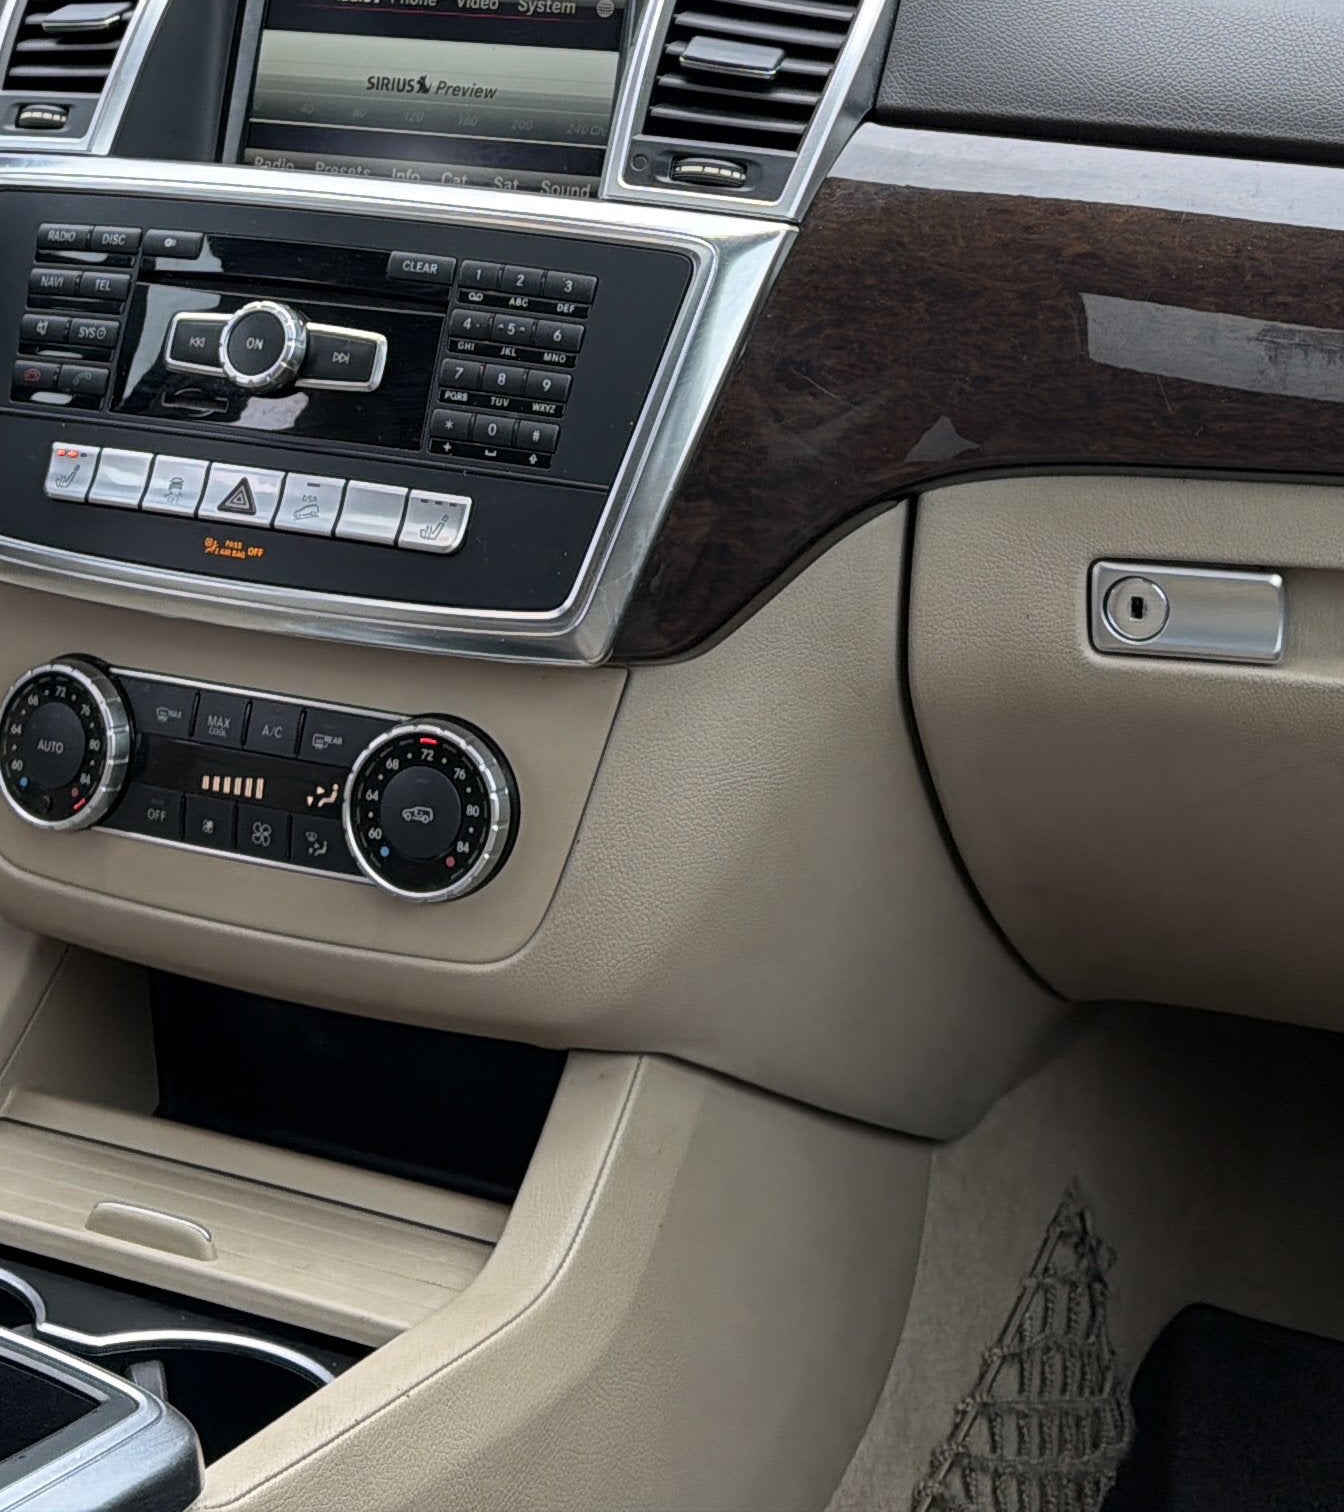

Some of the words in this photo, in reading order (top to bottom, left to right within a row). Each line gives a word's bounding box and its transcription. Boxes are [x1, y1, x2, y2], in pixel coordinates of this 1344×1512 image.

[366, 75, 416, 94] SIRIUS
[434, 81, 499, 100] Preview
[541, 180, 591, 199] Sound
[47, 230, 77, 242] RADIO
[101, 234, 126, 246] DISC
[402, 260, 438, 274] CLEAR
[40, 275, 64, 287] NAVI
[476, 269, 482, 281] 1
[516, 274, 525, 287] 2
[95, 280, 111, 292] TEL
[563, 279, 573, 293] 3
[508, 297, 529, 308] ABC
[556, 303, 575, 314] DEF
[462, 317, 471, 330] 4
[507, 322, 516, 336] 5
[78, 326, 96, 339] SYS
[553, 328, 562, 342] 6
[246, 337, 264, 350] ON
[457, 341, 475, 352] GHI
[500, 345, 517, 357] JKL
[543, 351, 567, 364] MNO
[455, 367, 464, 380] 7
[497, 372, 506, 386] 8
[542, 379, 552, 392] 9
[444, 390, 469, 402] PQRS
[490, 396, 510, 407] TUV
[532, 402, 557, 414] WXYZ
[225, 540, 243, 549] PASS
[247, 547, 265, 558] OFF
[56, 686, 66, 698] 72
[28, 694, 38, 706] 68
[81, 704, 91, 716] 76
[208, 715, 231, 729] MAX
[11, 724, 22, 734] 64
[261, 725, 283, 738] A/C
[37, 739, 64, 754] AUTO
[89, 739, 100, 751] 80
[325, 736, 343, 745] REAR
[421, 749, 434, 761] 72
[11, 760, 23, 771] 60
[386, 758, 399, 770] 68
[80, 773, 91, 785] 84
[454, 768, 466, 780] 76
[365, 789, 379, 801] 64
[147, 808, 167, 822] OFF
[466, 805, 479, 817] 80
[368, 828, 382, 840] 60
[457, 841, 470, 854] 84
